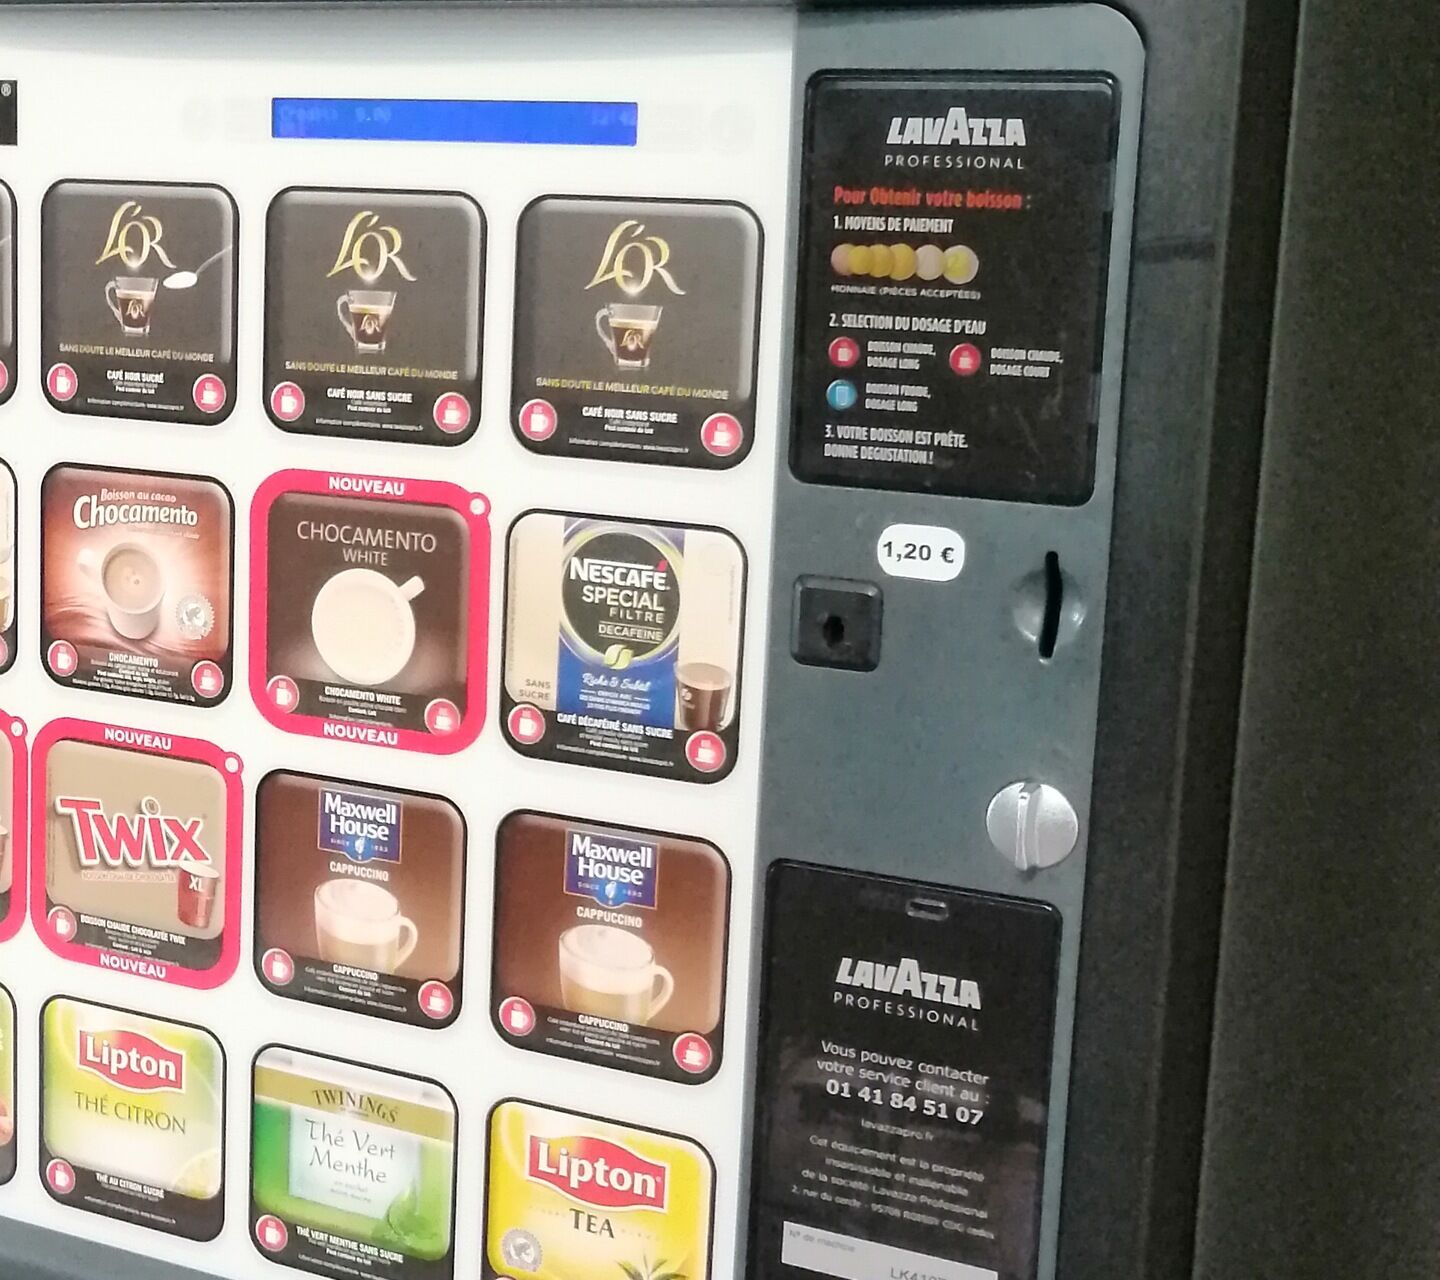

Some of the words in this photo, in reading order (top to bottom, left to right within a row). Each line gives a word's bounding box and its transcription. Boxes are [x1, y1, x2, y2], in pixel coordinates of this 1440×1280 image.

[886, 107, 1026, 147] LAVAZZA
[885, 155, 1024, 170] PROFESSIONAL
[834, 186, 865, 205] Pour
[869, 187, 921, 206] Obtenir
[926, 190, 962, 207] votre
[966, 190, 1022, 209] boisson
[95, 200, 176, 269] L'OR
[834, 215, 842, 229] 1.
[845, 216, 886, 231] MOYENS
[887, 217, 901, 231] DE
[903, 218, 954, 234] PAIEMENT
[326, 211, 417, 282] L'OR
[584, 220, 686, 295] L'OR
[829, 314, 838, 327] 2.
[895, 317, 909, 331] DU
[912, 317, 952, 333] DOSAGE
[954, 320, 986, 335] D'EAU
[286, 361, 306, 371] SANS
[336, 365, 346, 373] LE
[327, 388, 345, 398] CAFÉ
[365, 391, 386, 401] SANS
[582, 406, 603, 417] CAFÉ
[626, 410, 647, 421] SANS
[101, 489, 135, 502] Boisson
[137, 492, 149, 500] au
[151, 494, 176, 502] cacao
[329, 476, 405, 496] NOUVEAU
[73, 496, 198, 529] Chocamento
[297, 521, 437, 553] CHOCAMENTO
[343, 548, 388, 565] WHITE
[884, 541, 931, 562] 1,20
[940, 547, 954, 563] €
[582, 587, 664, 611] SPECIAL
[610, 607, 664, 623] FILTRE
[519, 690, 550, 700] SUCRE
[526, 679, 550, 689] SANS
[105, 728, 172, 750] NOUVEAU
[324, 722, 398, 745] NOUVEAU
[324, 793, 396, 824] Maxwell
[330, 815, 389, 841] House
[572, 834, 652, 868] Maxwell
[189, 875, 203, 892] XL
[330, 862, 389, 881] CAPPUCCINO
[578, 857, 643, 885] House
[577, 906, 642, 928] CAPPUCCINO
[100, 954, 166, 978] NOUVEAU
[836, 957, 981, 1010] LAVAZZA
[833, 992, 979, 1031] PROFESSIONAL
[86, 1034, 177, 1081] Lipton
[822, 1040, 856, 1058] Vous
[861, 1051, 913, 1070] pouvez
[918, 1062, 990, 1086] contacter
[817, 1060, 854, 1076] votre
[859, 1068, 911, 1088] service
[916, 1080, 956, 1097] client
[960, 1089, 979, 1102] au
[75, 1091, 108, 1115] THÉ
[114, 1102, 186, 1135] CITRON
[312, 1089, 398, 1123] TWININGS
[826, 1080, 851, 1098] 01
[858, 1088, 883, 1105] 41
[890, 1093, 917, 1112] 84
[923, 1100, 948, 1119] 51
[956, 1106, 984, 1126] 07
[305, 1118, 344, 1146] Thé
[352, 1130, 395, 1160] Vert
[309, 1146, 387, 1184] Menthe
[538, 1141, 656, 1198] Lipton
[570, 1208, 614, 1238] TEA
